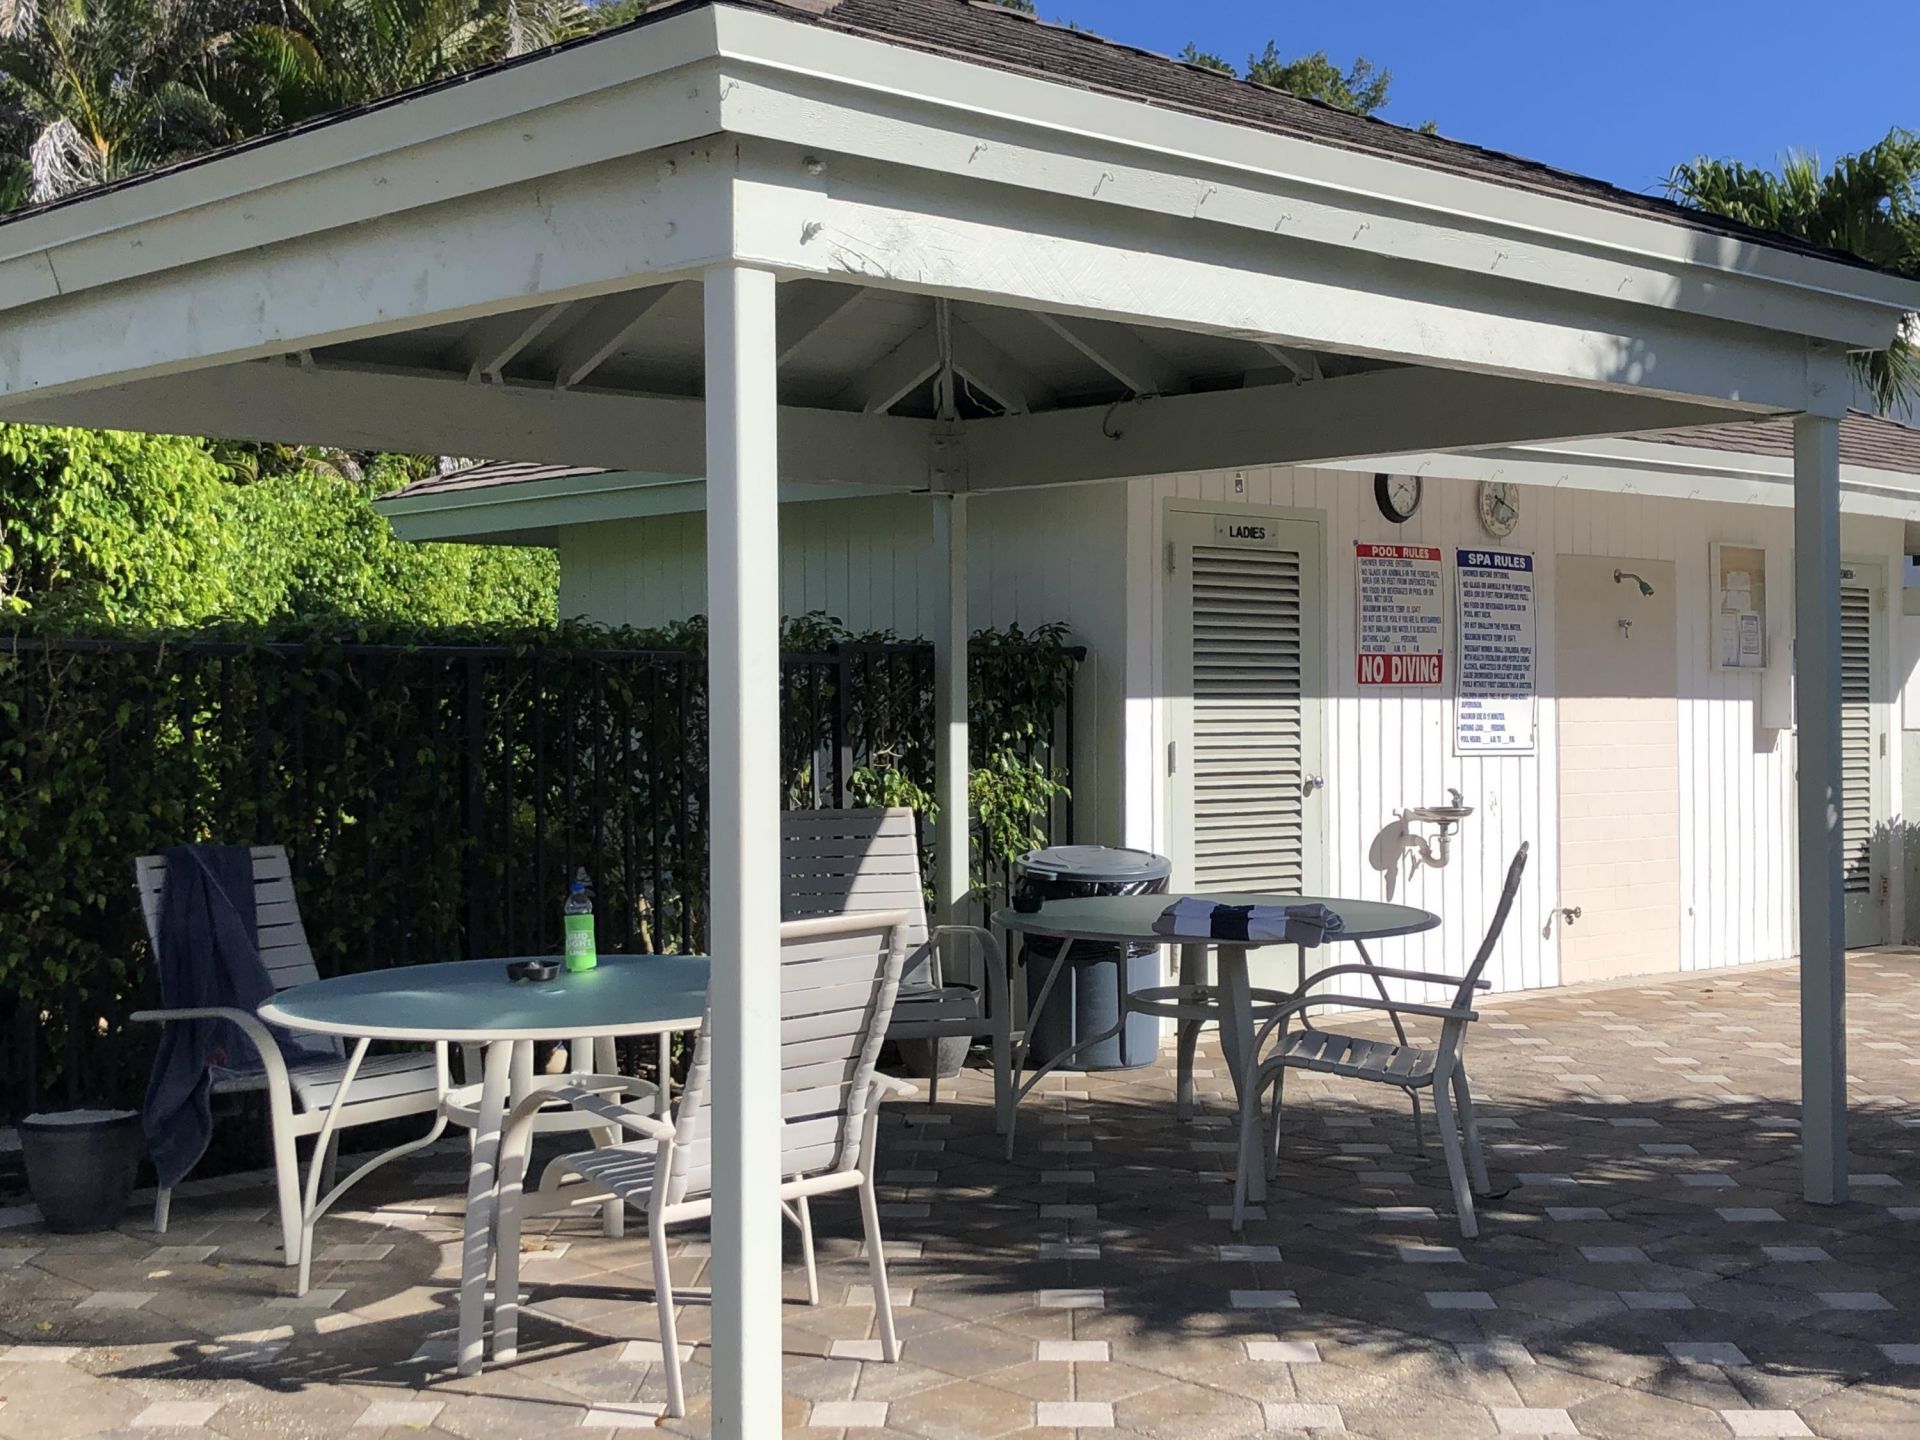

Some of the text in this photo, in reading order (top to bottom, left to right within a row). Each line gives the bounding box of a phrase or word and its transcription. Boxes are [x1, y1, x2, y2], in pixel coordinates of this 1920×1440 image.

[1229, 525, 1265, 539] LADIES
[1372, 546, 1429, 558] POOL RULES
[1468, 553, 1526, 568] SPA RULES
[1362, 656, 1438, 682] NO DIVING
